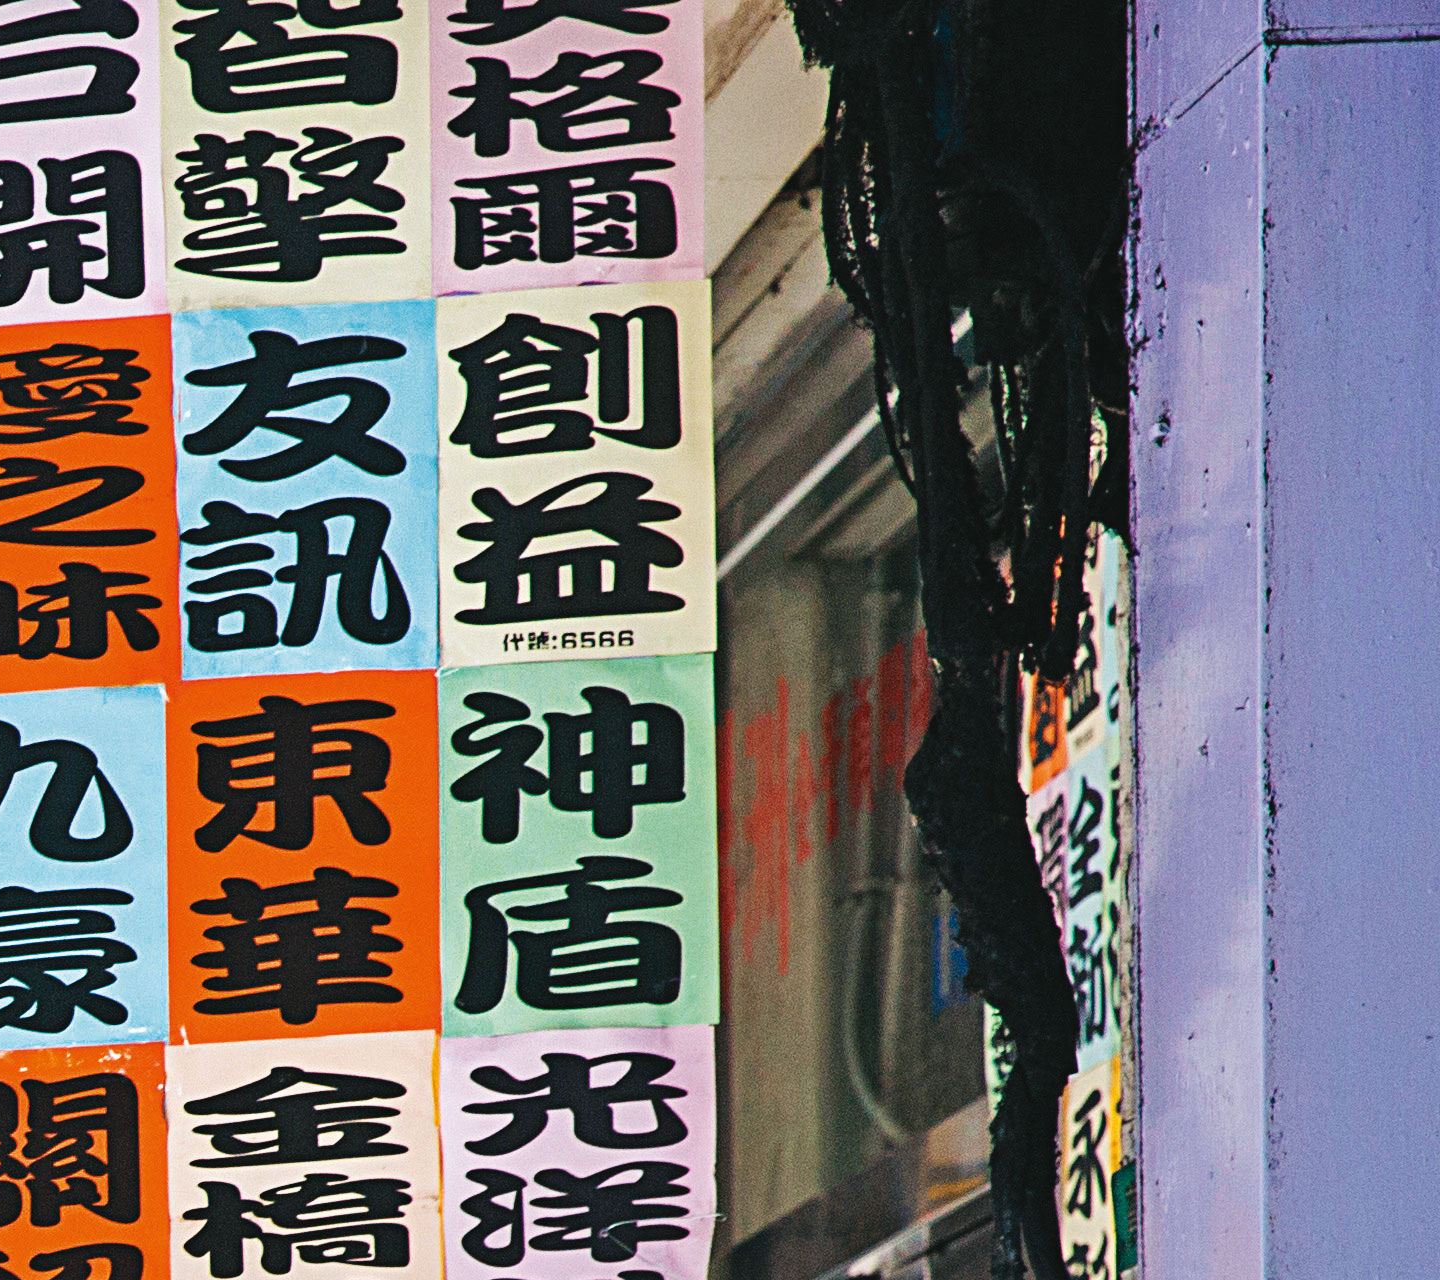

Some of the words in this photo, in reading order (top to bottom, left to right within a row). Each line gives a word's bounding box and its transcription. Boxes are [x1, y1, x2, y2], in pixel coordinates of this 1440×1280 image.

[179, 332, 410, 652] 友訊
[449, 306, 684, 625] 創益
[503, 630, 635, 652] 代號:6566
[190, 696, 403, 1024] 東華
[451, 687, 685, 1014] 神盾
